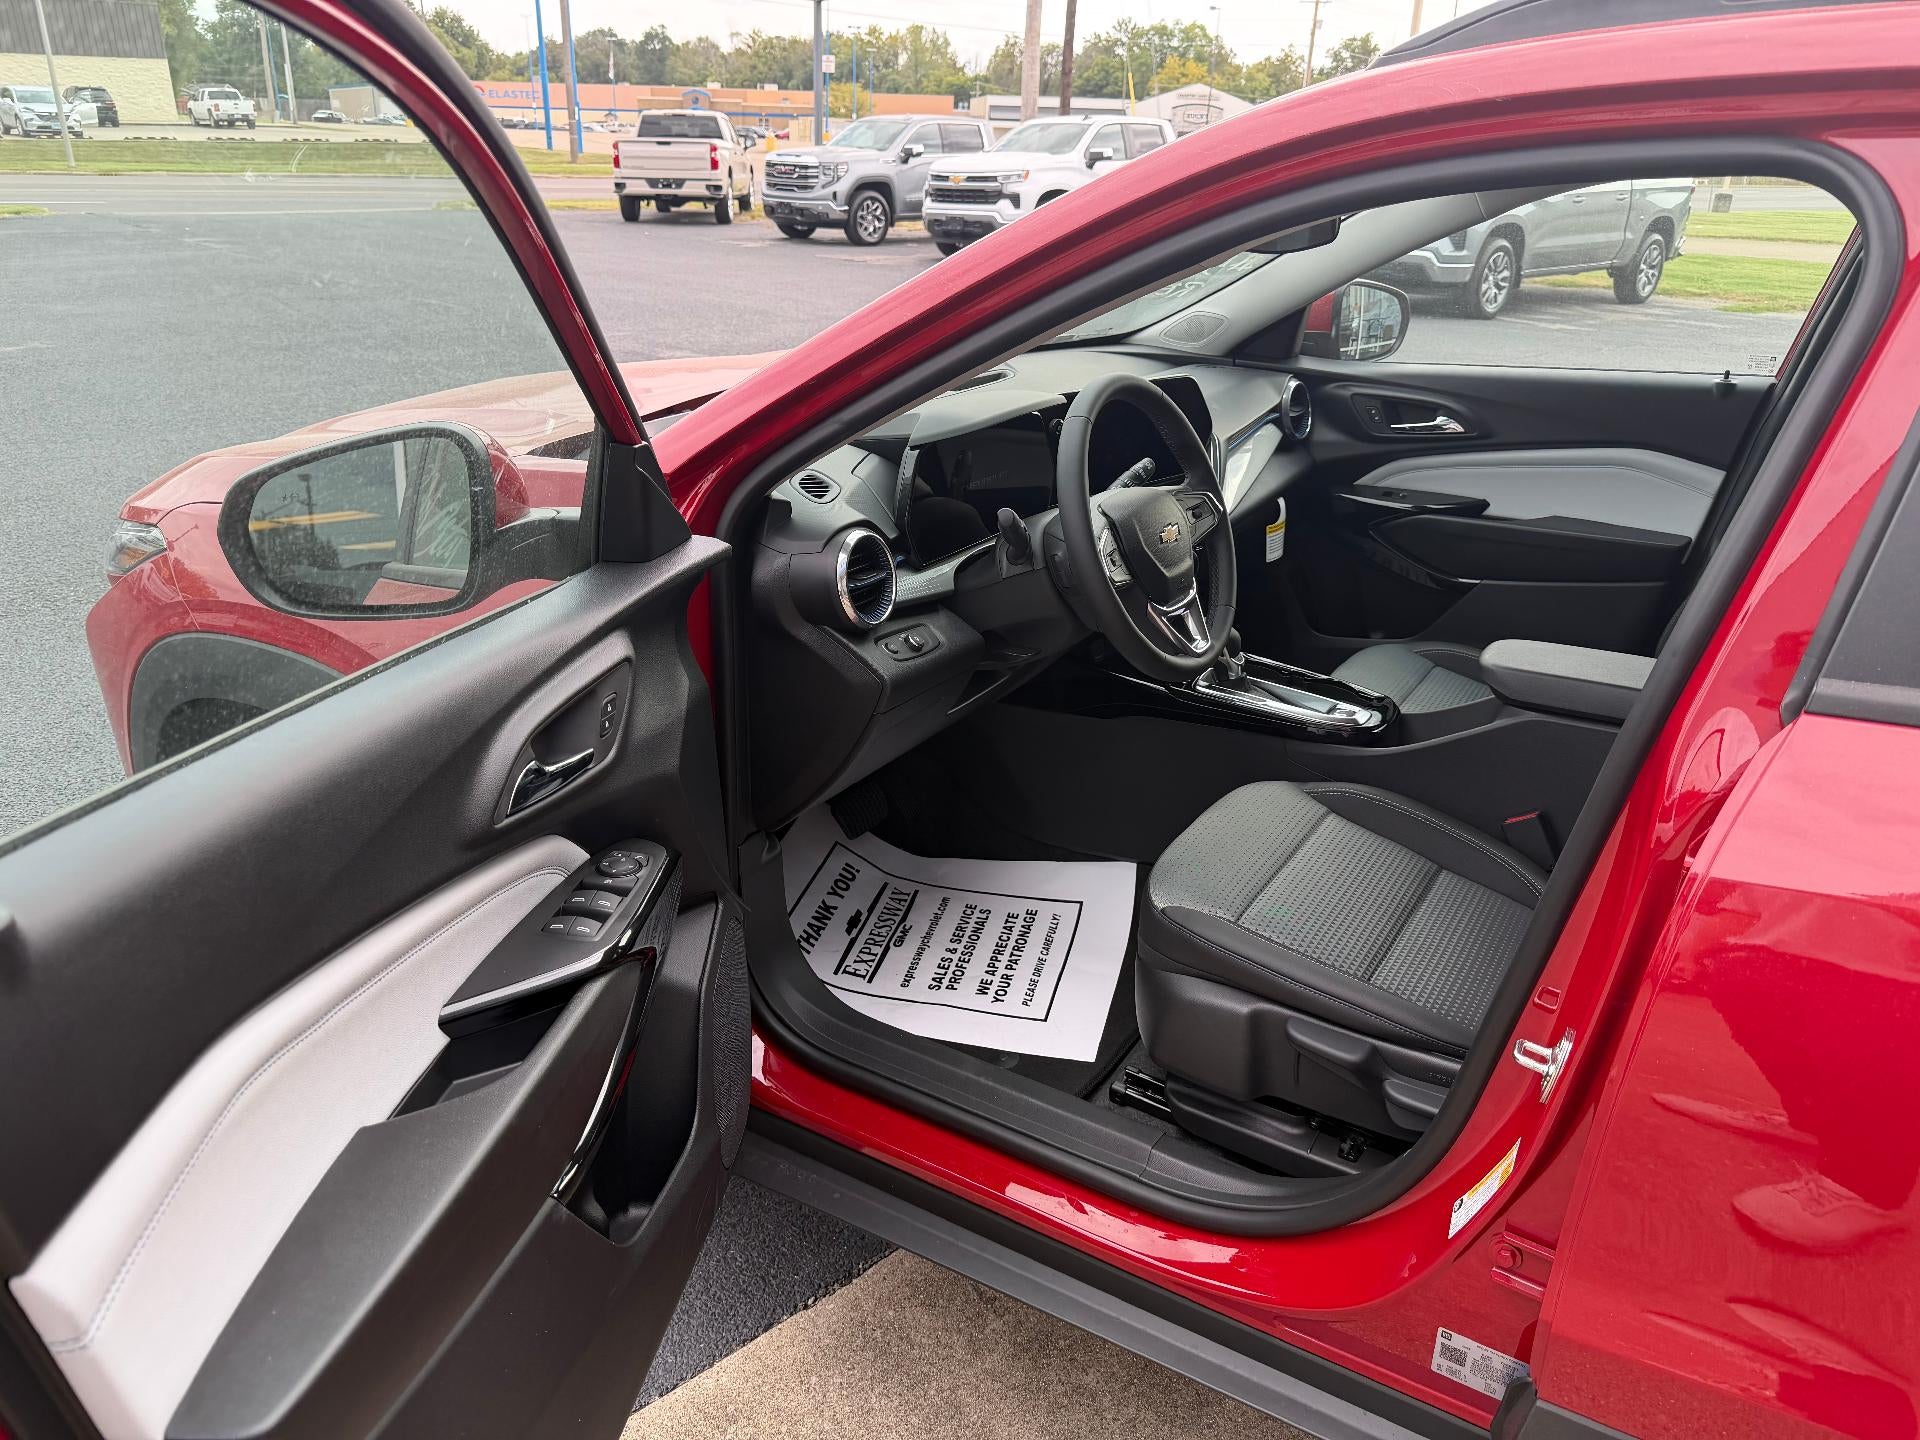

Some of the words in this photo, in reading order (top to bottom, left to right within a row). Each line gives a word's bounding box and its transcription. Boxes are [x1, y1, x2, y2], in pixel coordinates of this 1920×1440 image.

[796, 898, 839, 955] THANK
[826, 862, 861, 899] YOU!
[841, 887, 911, 980] EXPRESSWAY
[893, 923, 913, 948] GMC
[900, 896, 951, 988] expresswaychevrolet.com
[949, 903, 978, 945] SERVICE
[984, 911, 1020, 977] APPRECIATE
[927, 956, 954, 991] SALES
[945, 908, 992, 991] PROFESSIONALS
[945, 947, 958, 955] &
[991, 973, 1015, 1004] YOUR
[1004, 908, 1039, 971] PATRONAGE
[1021, 977, 1040, 1007] PLEASE
[1032, 956, 1048, 978] DRIVE
[1040, 913, 1062, 957] CAREFULLY!
[975, 978, 994, 996] WE
